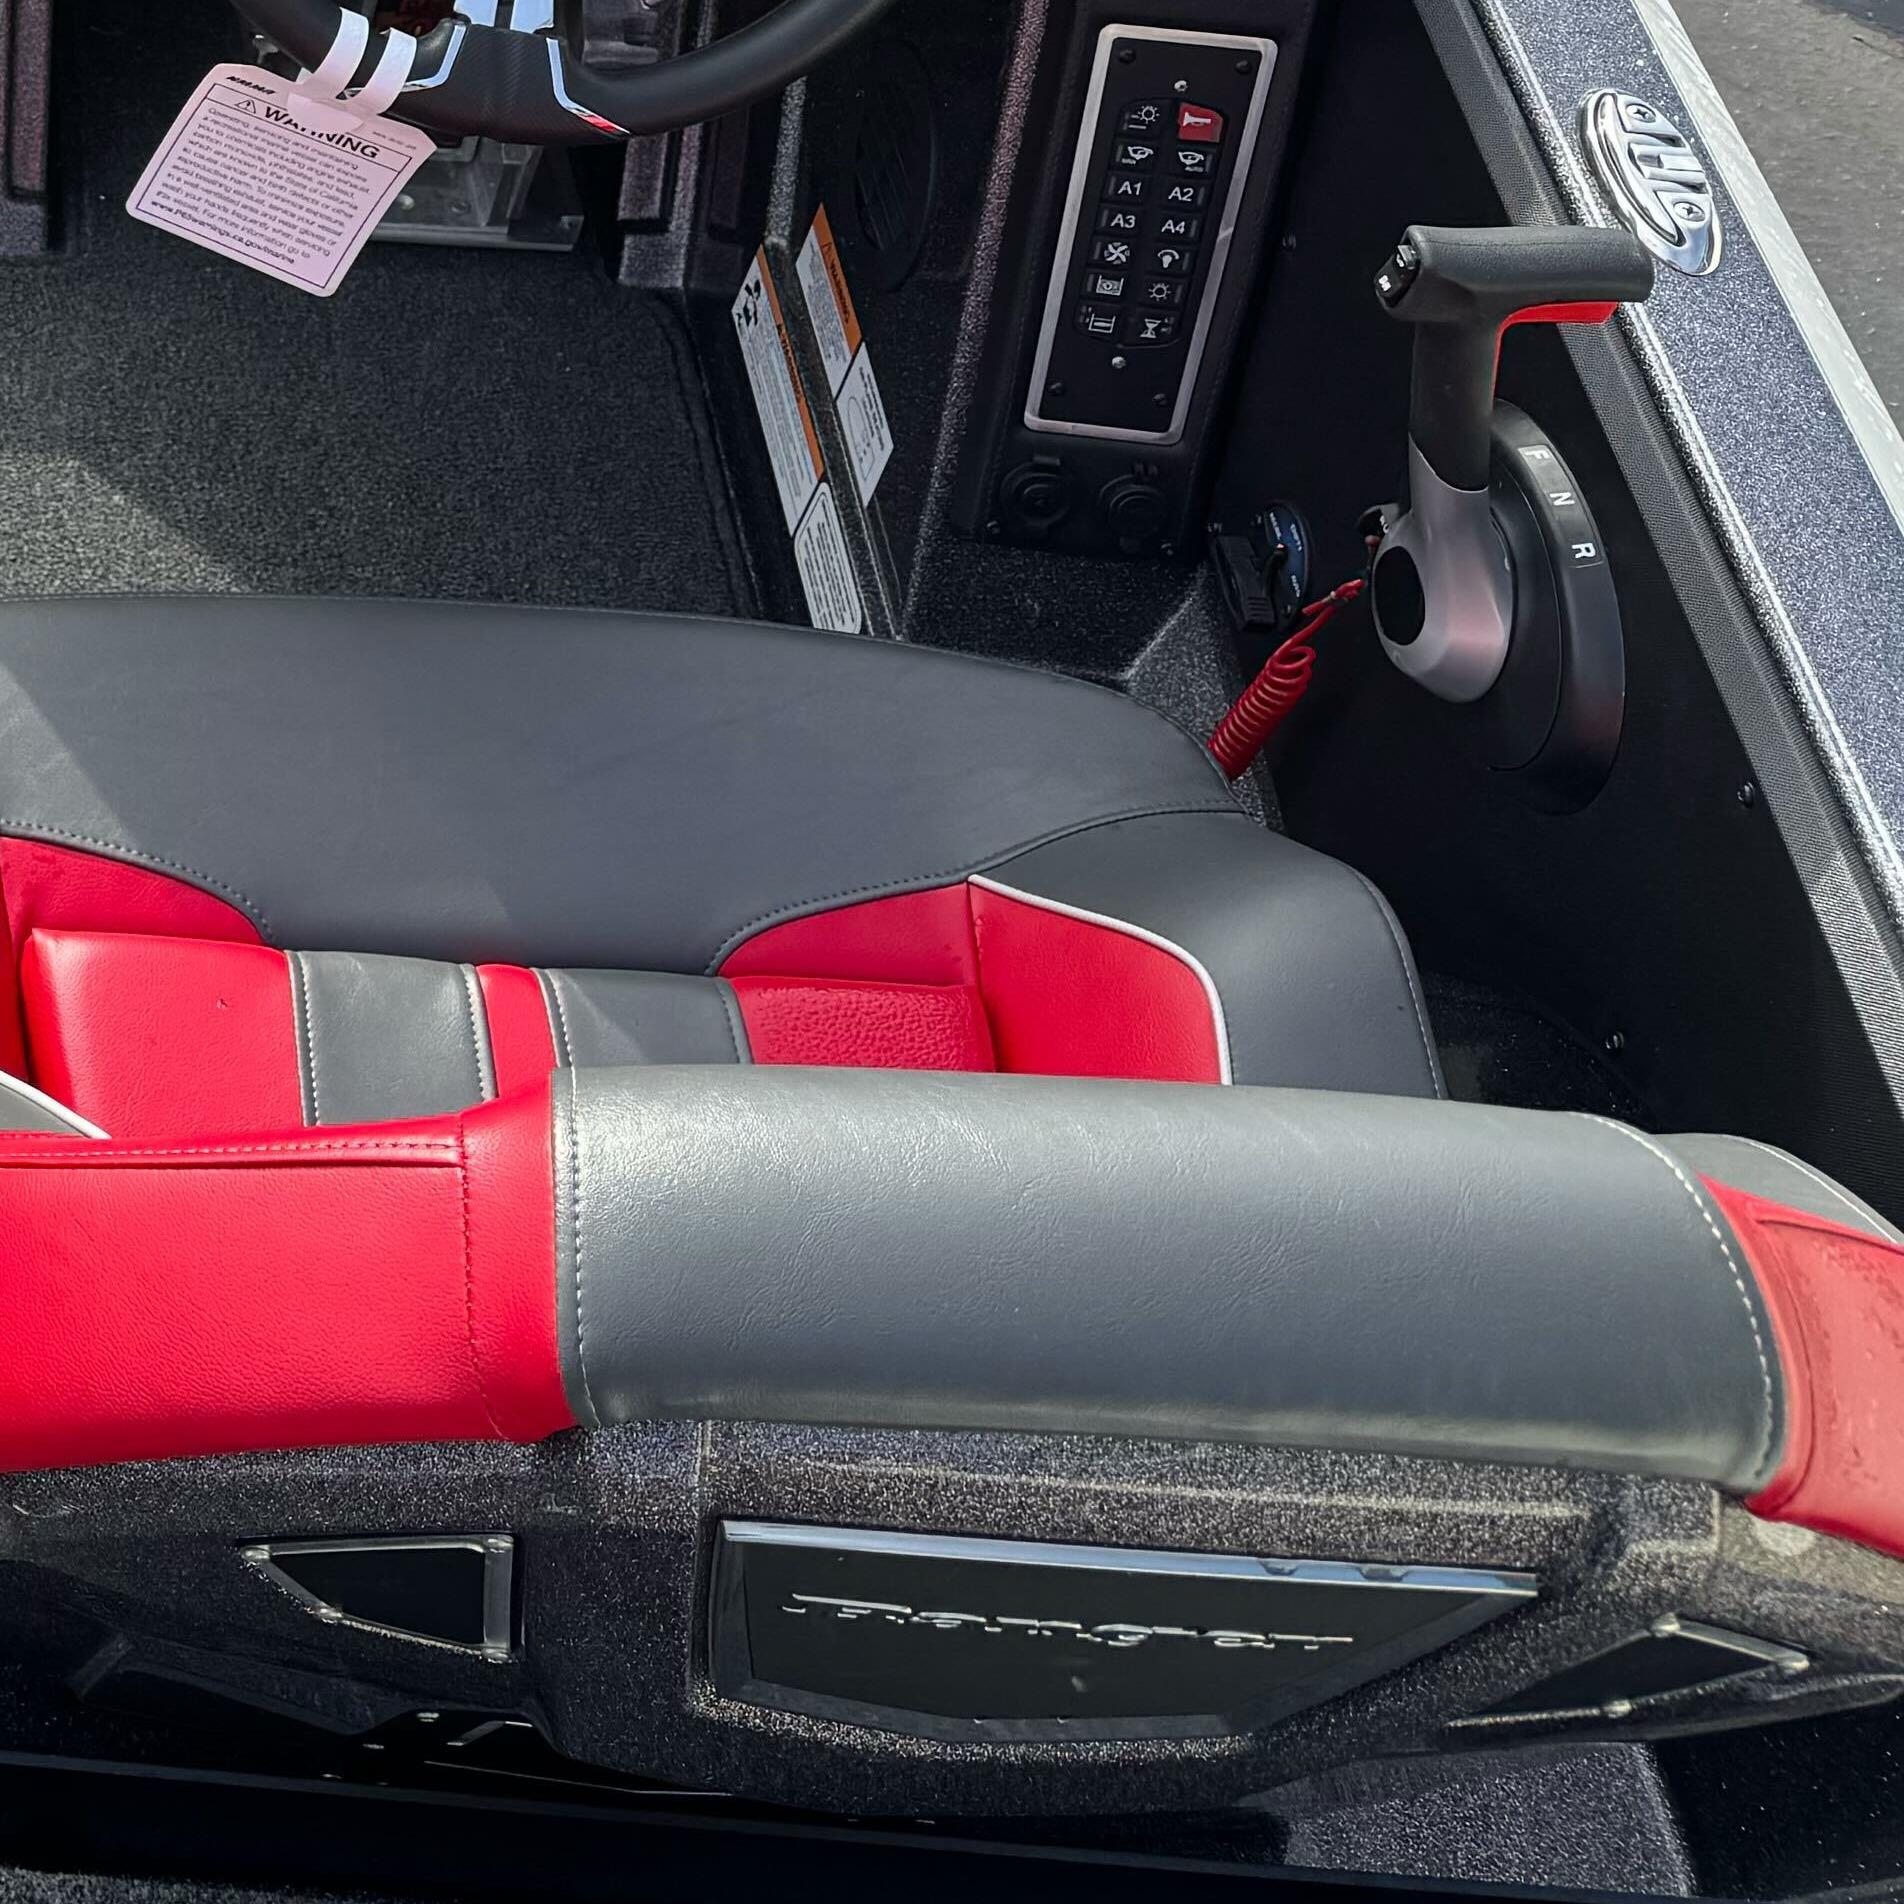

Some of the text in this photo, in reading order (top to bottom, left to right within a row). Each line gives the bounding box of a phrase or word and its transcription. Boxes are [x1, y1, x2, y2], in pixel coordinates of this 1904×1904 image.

[264, 105, 380, 160] WANING
[1118, 181, 1142, 196] A1
[1168, 186, 1194, 202] A2
[1110, 213, 1135, 229] A3
[1161, 219, 1186, 234] A4
[1550, 491, 1574, 506] N
[1572, 542, 1596, 559] R
